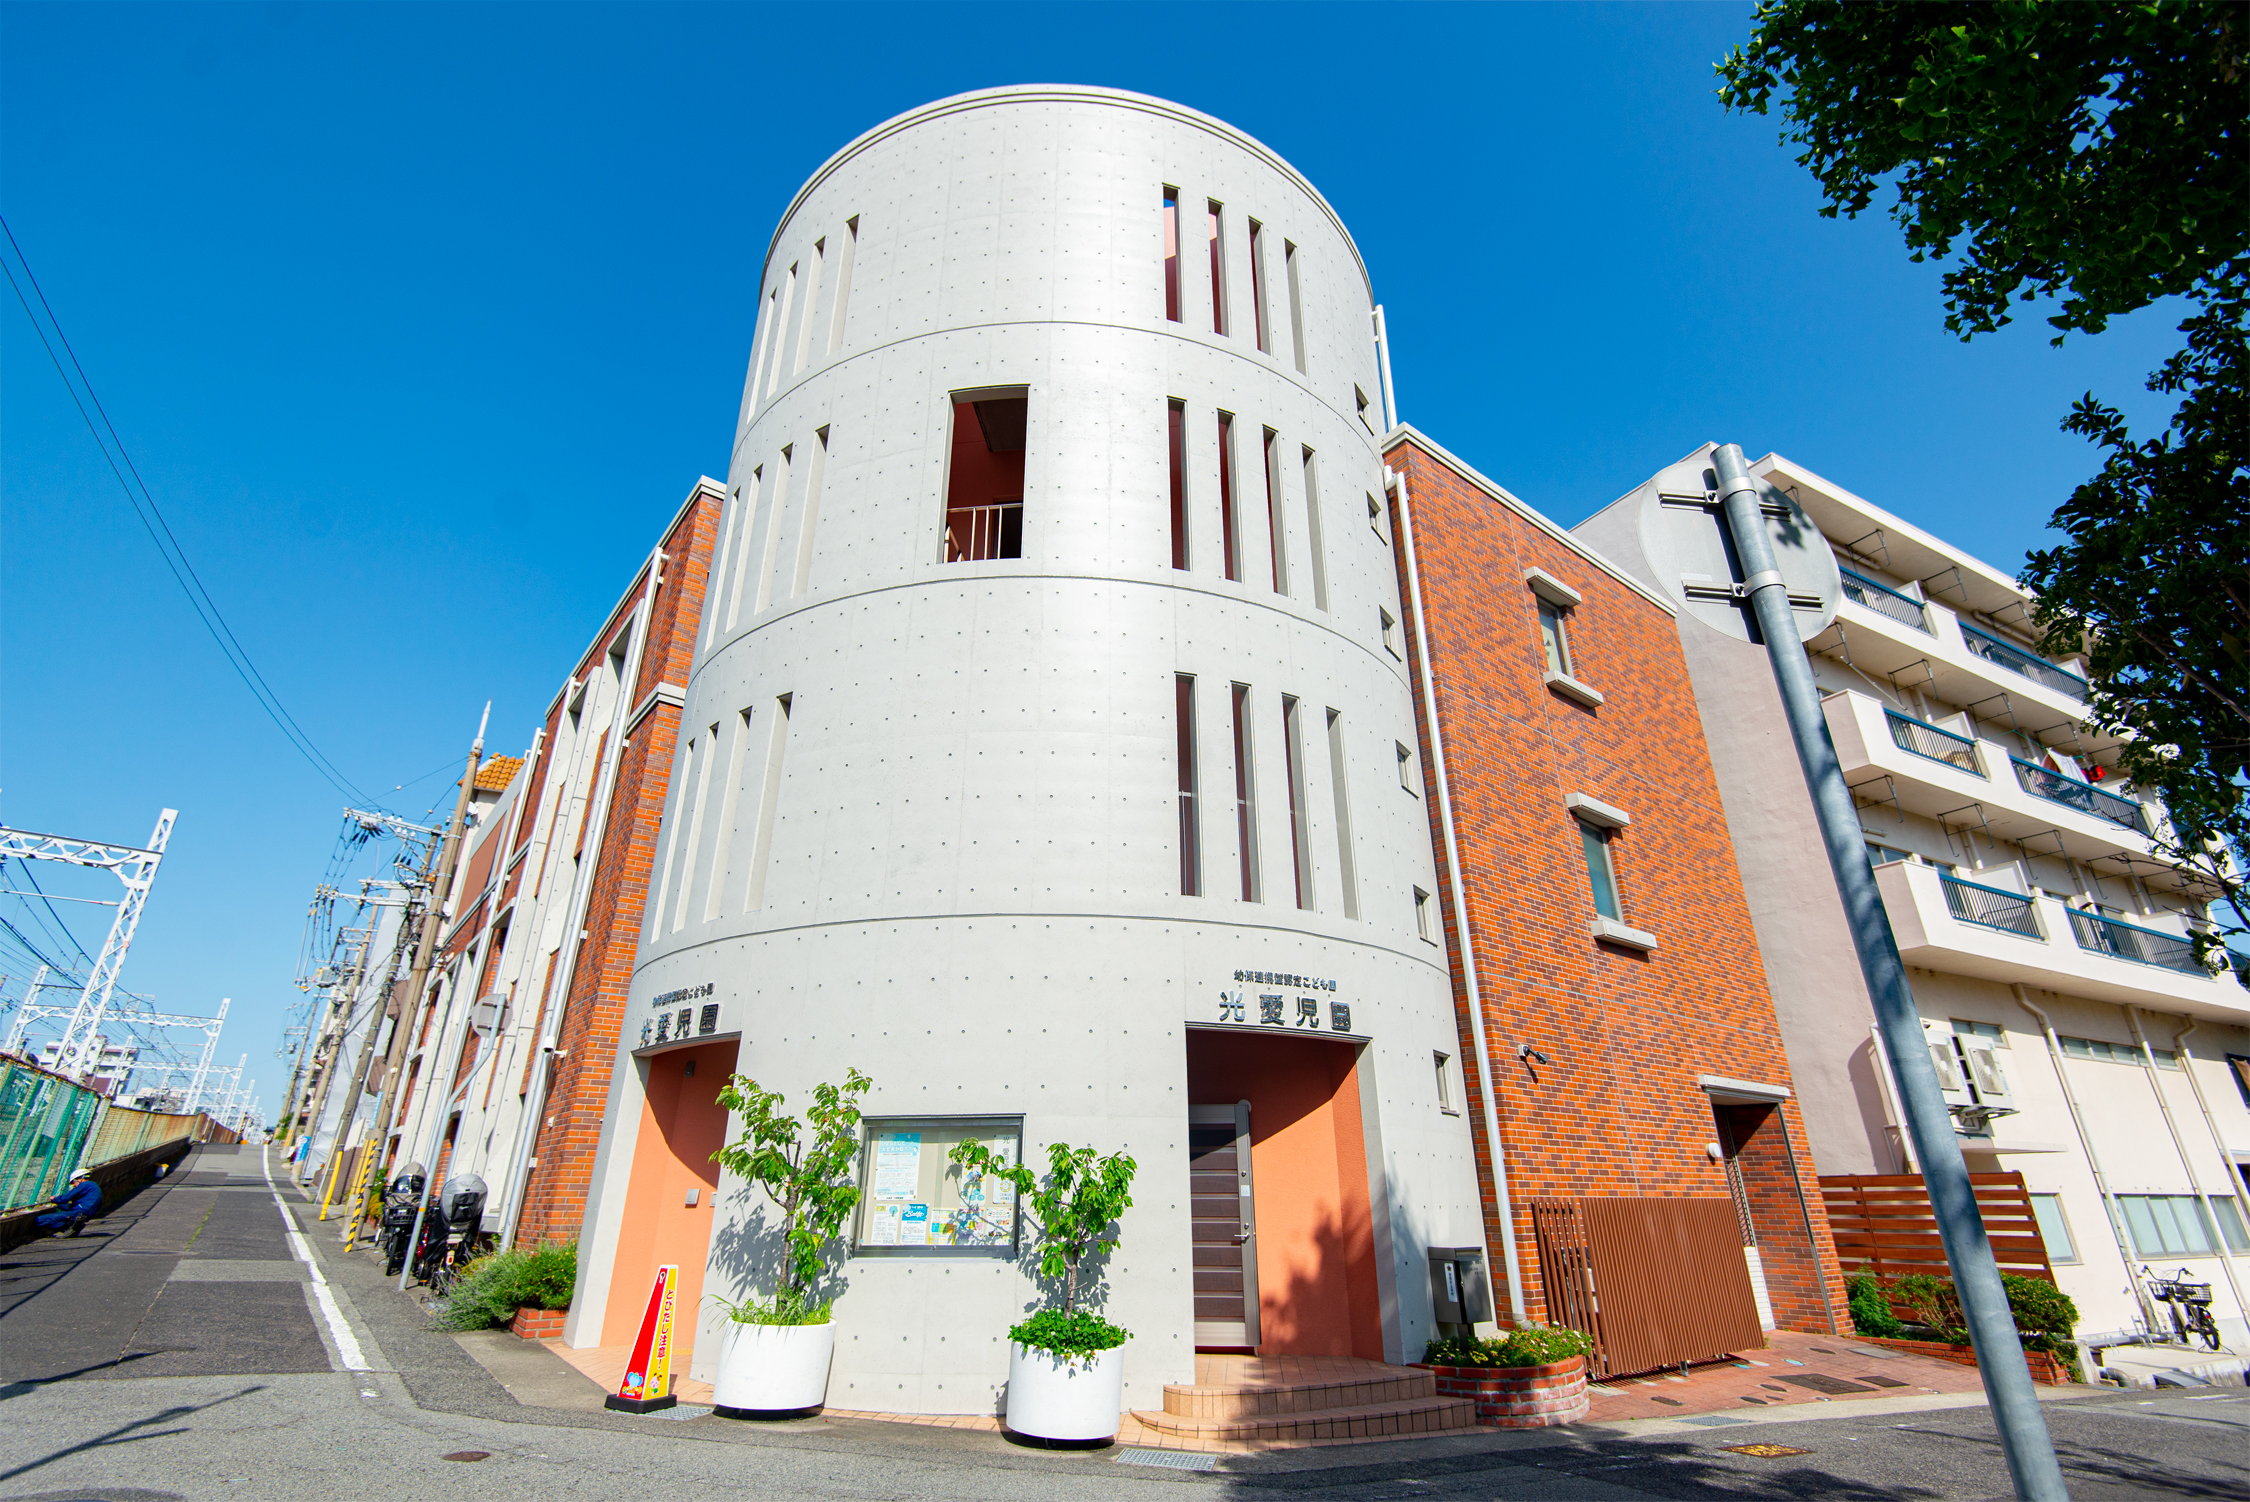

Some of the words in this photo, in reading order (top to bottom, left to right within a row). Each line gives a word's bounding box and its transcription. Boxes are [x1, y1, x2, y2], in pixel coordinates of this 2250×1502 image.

[1234, 969, 1336, 991] 幼保連携型認定こども園
[639, 1003, 719, 1045] 光愛児園
[1219, 990, 1352, 1032] 光愛児園
[656, 1289, 674, 1370] とびだし注意!
